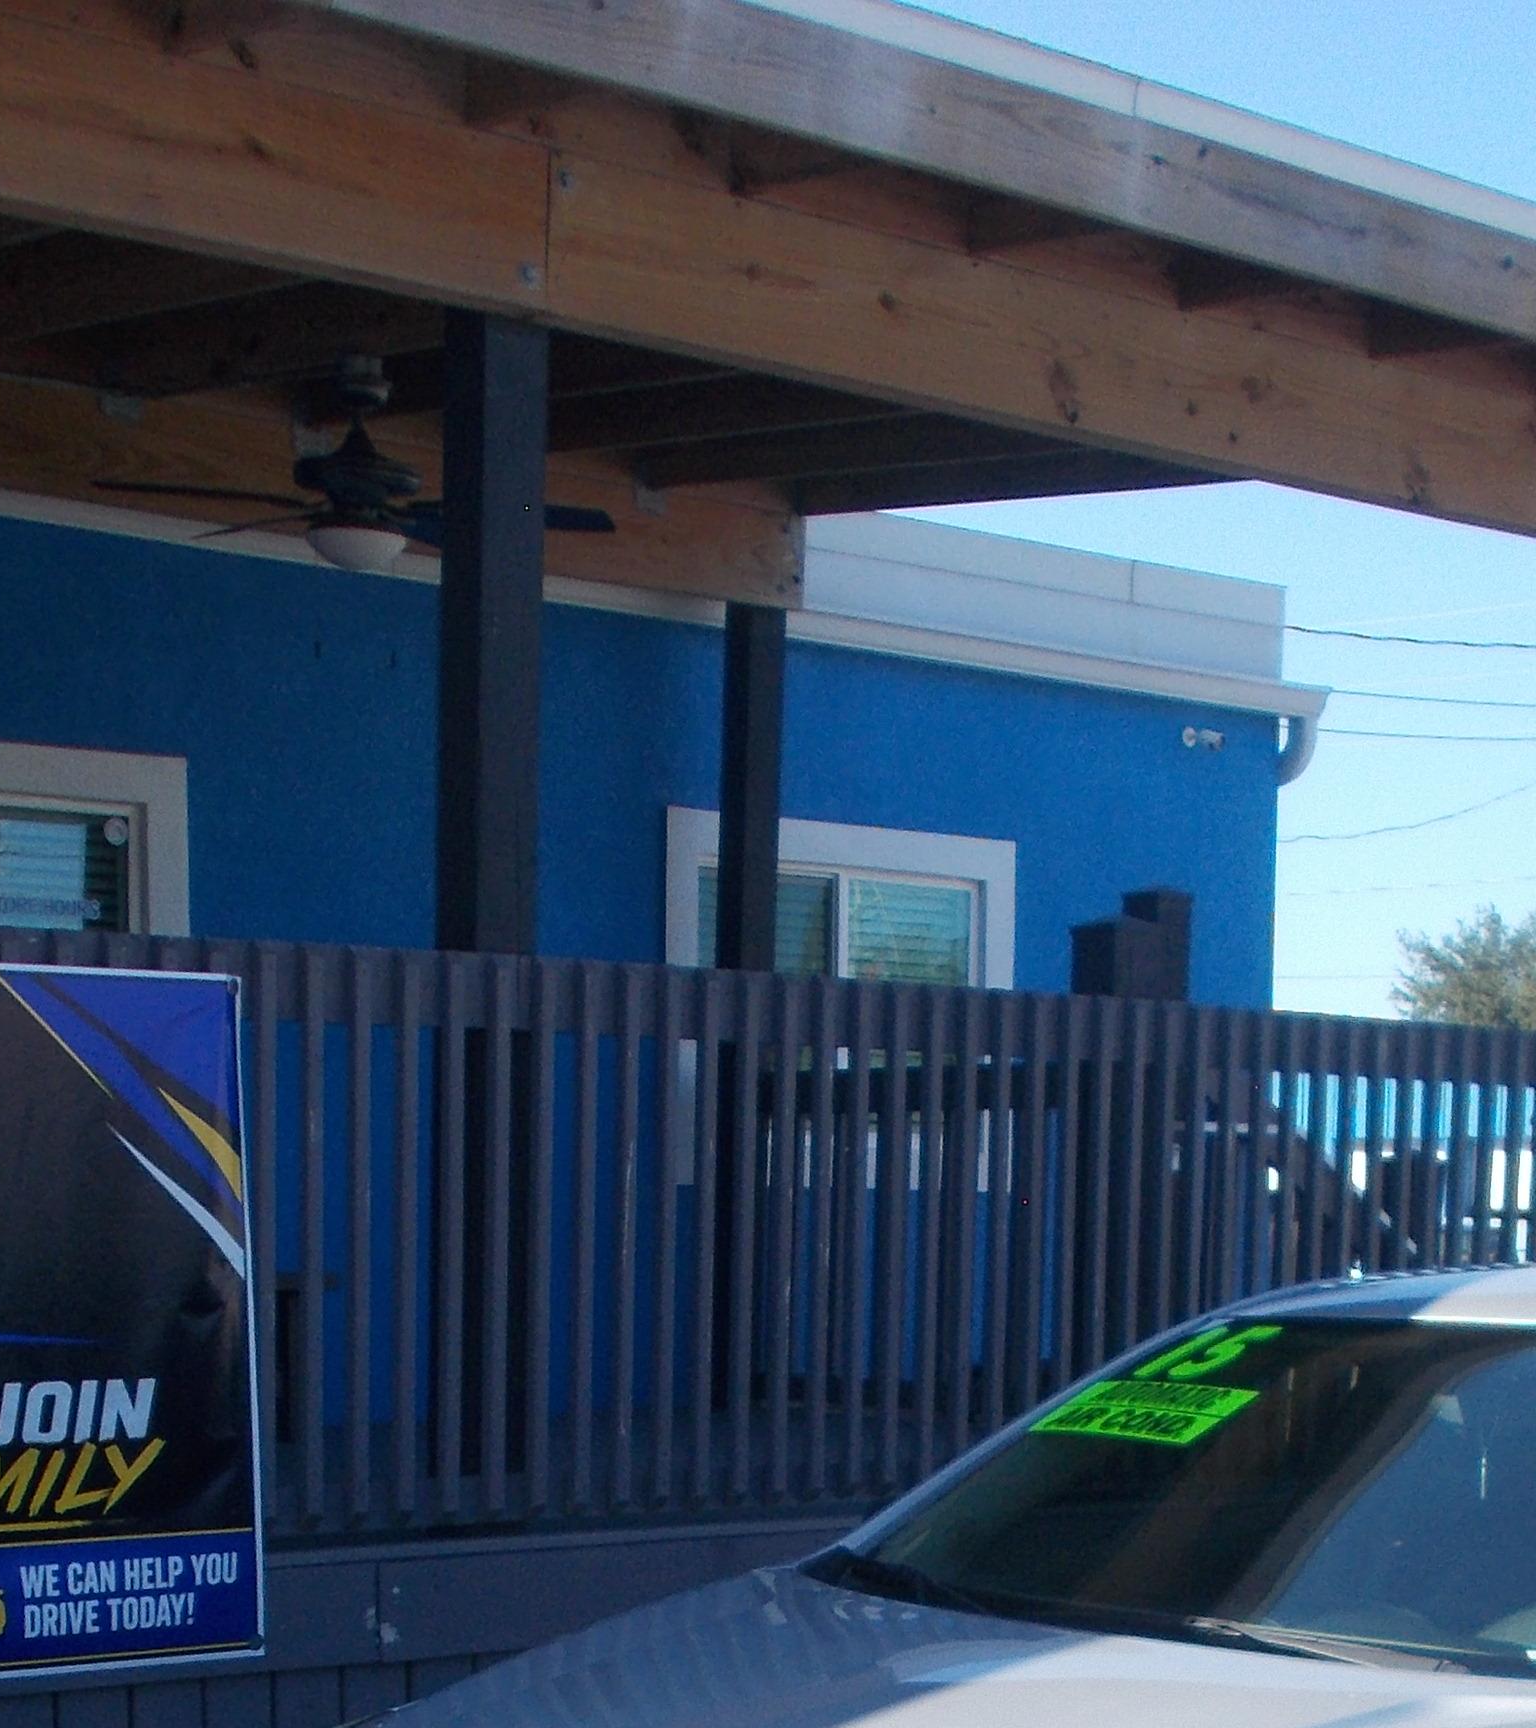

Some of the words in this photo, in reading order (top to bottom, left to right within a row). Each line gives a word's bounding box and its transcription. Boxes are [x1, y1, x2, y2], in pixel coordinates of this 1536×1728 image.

[1044, 1405, 1111, 1430] AIR
[20, 1564, 60, 1599] WE
[67, 1560, 116, 1595] CAN
[124, 1556, 184, 1591] HELP
[190, 1552, 238, 1586] YOU
[24, 1600, 100, 1638] DRIVE
[106, 1592, 195, 1631] TODAY!
